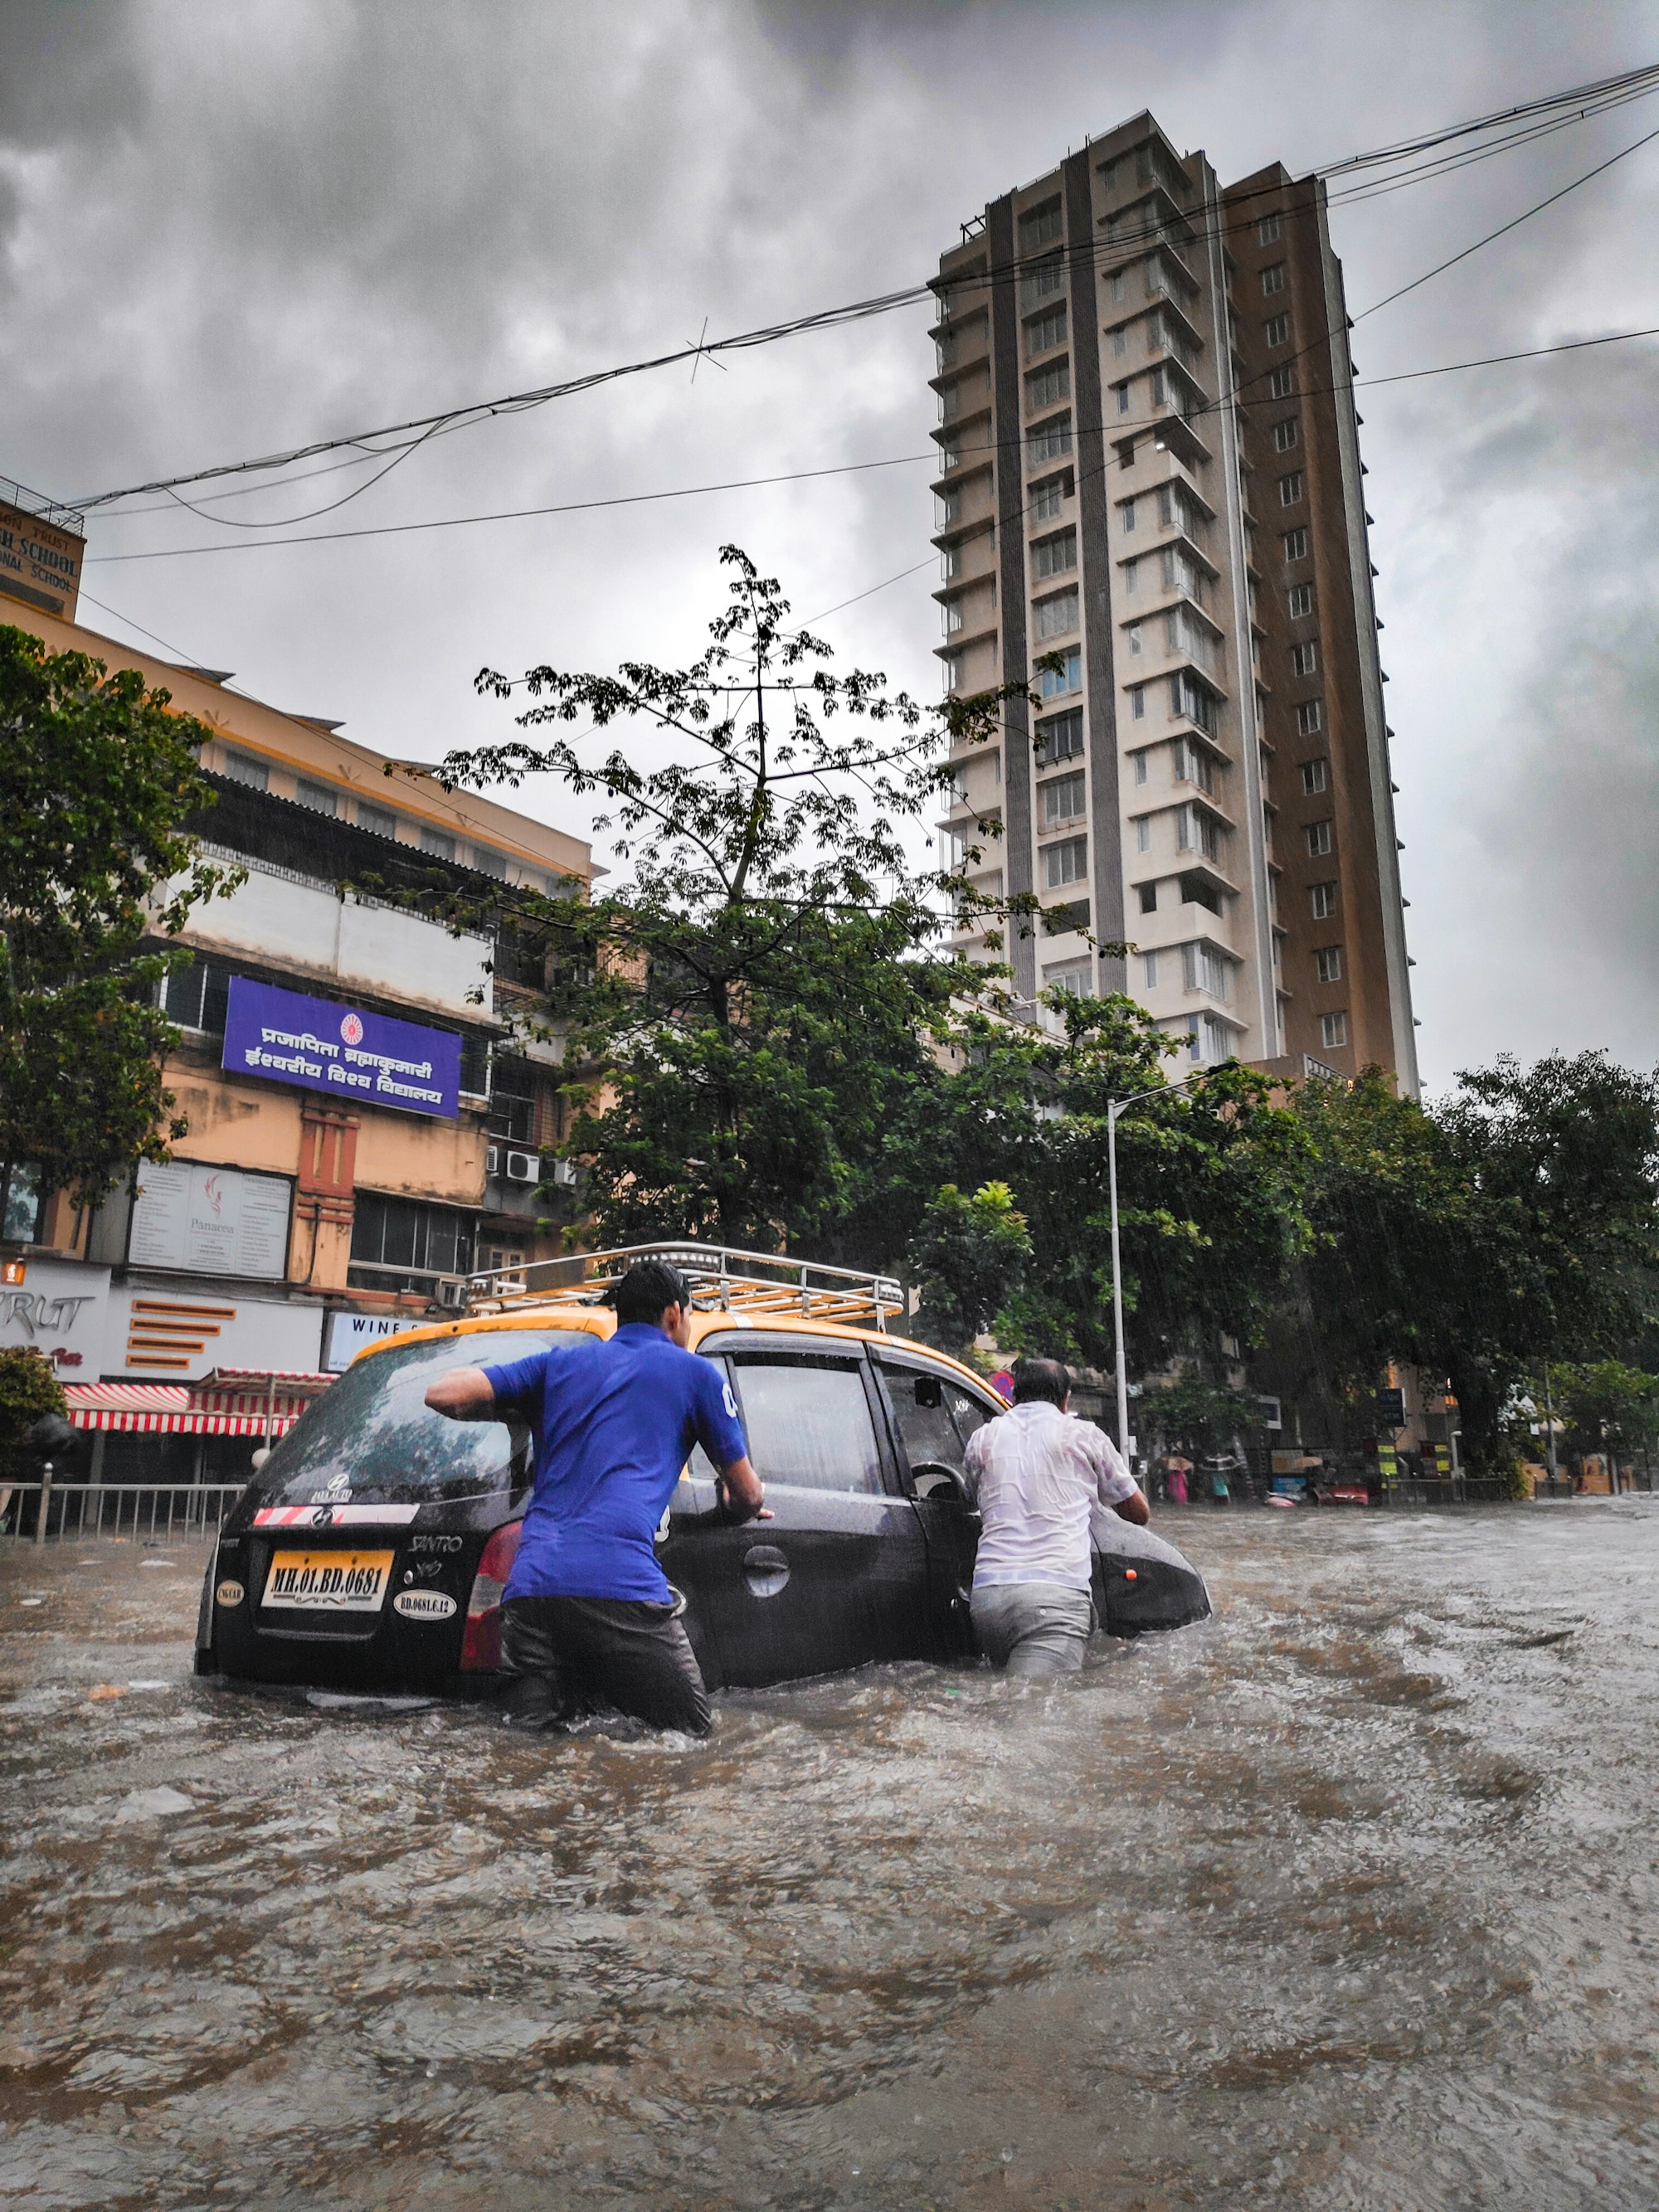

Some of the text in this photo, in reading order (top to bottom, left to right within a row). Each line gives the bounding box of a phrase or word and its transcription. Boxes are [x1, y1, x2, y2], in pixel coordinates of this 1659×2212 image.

[0, 527, 78, 578] H SCHOOL
[32, 526, 69, 552] TRUST
[31, 562, 72, 594] SCHOOL
[260, 1027, 340, 1058] प्रजापिता
[245, 1046, 443, 1105] ईश्वरीय विश्व विद्यालय
[191, 1218, 235, 1234] Panacea
[0, 1291, 96, 1339] RUT
[353, 1318, 400, 1334] WINE
[270, 1567, 382, 1596] MH.01.BD.0681
